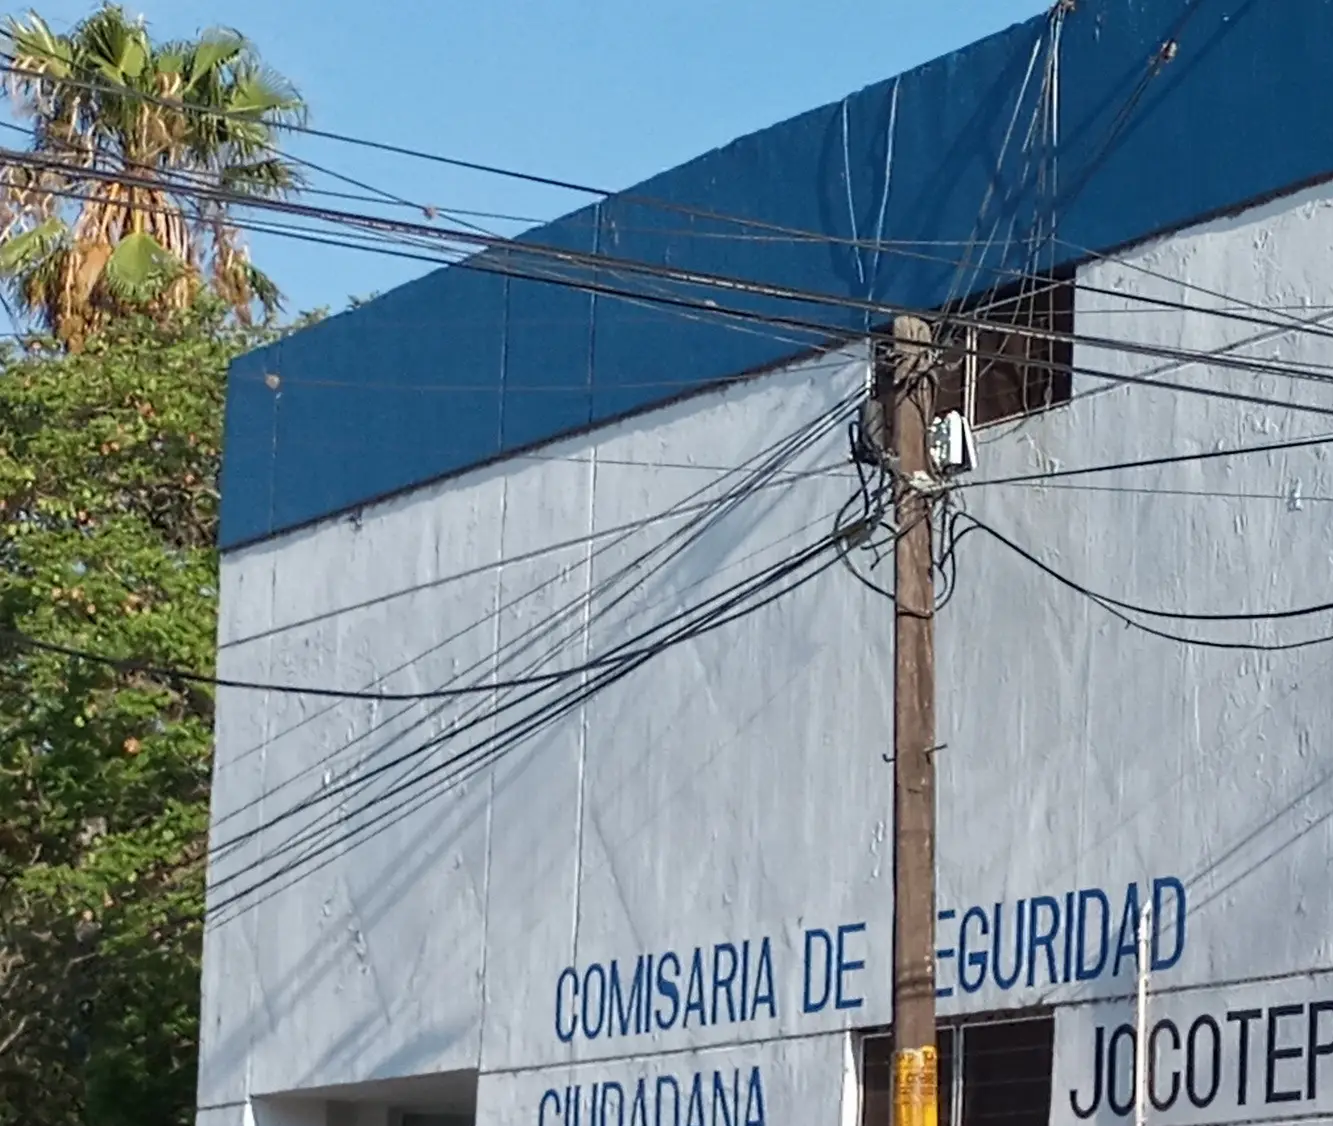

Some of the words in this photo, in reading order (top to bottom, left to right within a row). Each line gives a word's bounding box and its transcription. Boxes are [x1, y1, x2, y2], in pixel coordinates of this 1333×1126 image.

[555, 936, 777, 1043] COMISARIA
[802, 922, 866, 1014] DE
[934, 876, 1187, 998] EGURIDAD
